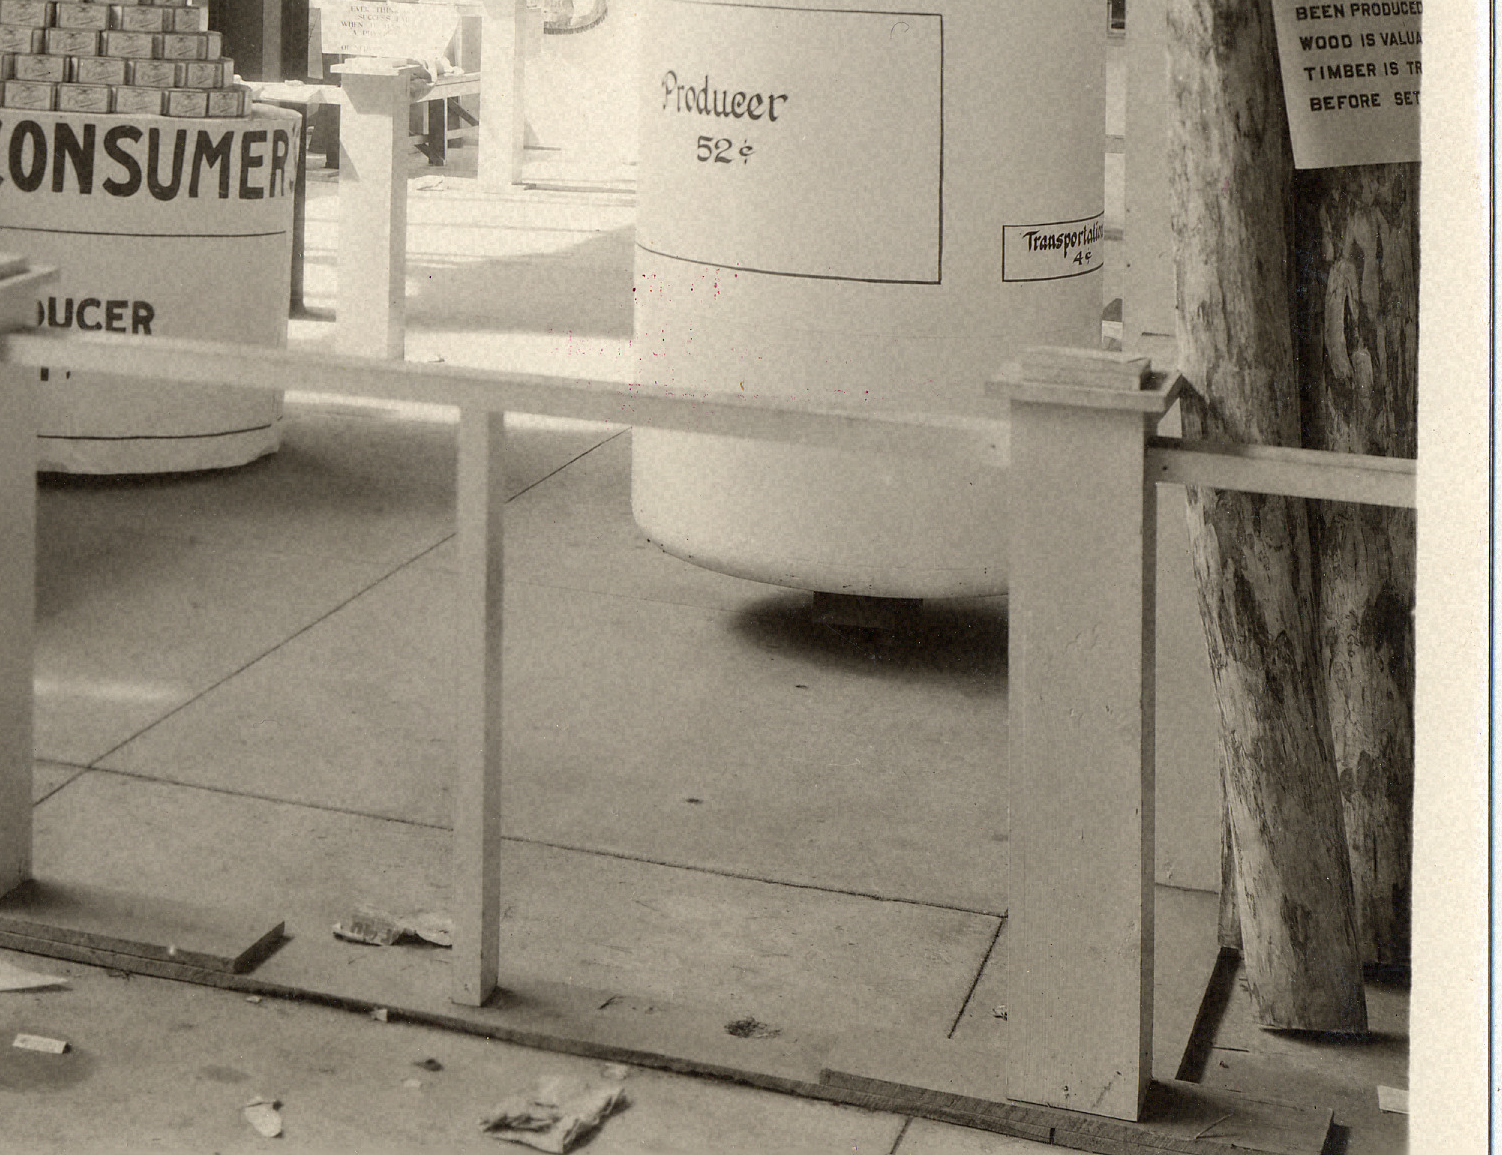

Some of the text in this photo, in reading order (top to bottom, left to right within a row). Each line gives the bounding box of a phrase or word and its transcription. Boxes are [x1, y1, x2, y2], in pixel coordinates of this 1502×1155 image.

[1295, 1, 1423, 21] BEEN PRODUCED
[1299, 33, 1353, 51] WOOD
[1361, 33, 1375, 47] IS
[1303, 61, 1376, 81] TIMBER
[1384, 61, 1398, 76] IS
[661, 70, 788, 122] Producer
[1310, 93, 1381, 111] BEFORE
[697, 135, 756, 165] 52¢
[1072, 248, 1093, 265] 4¢
